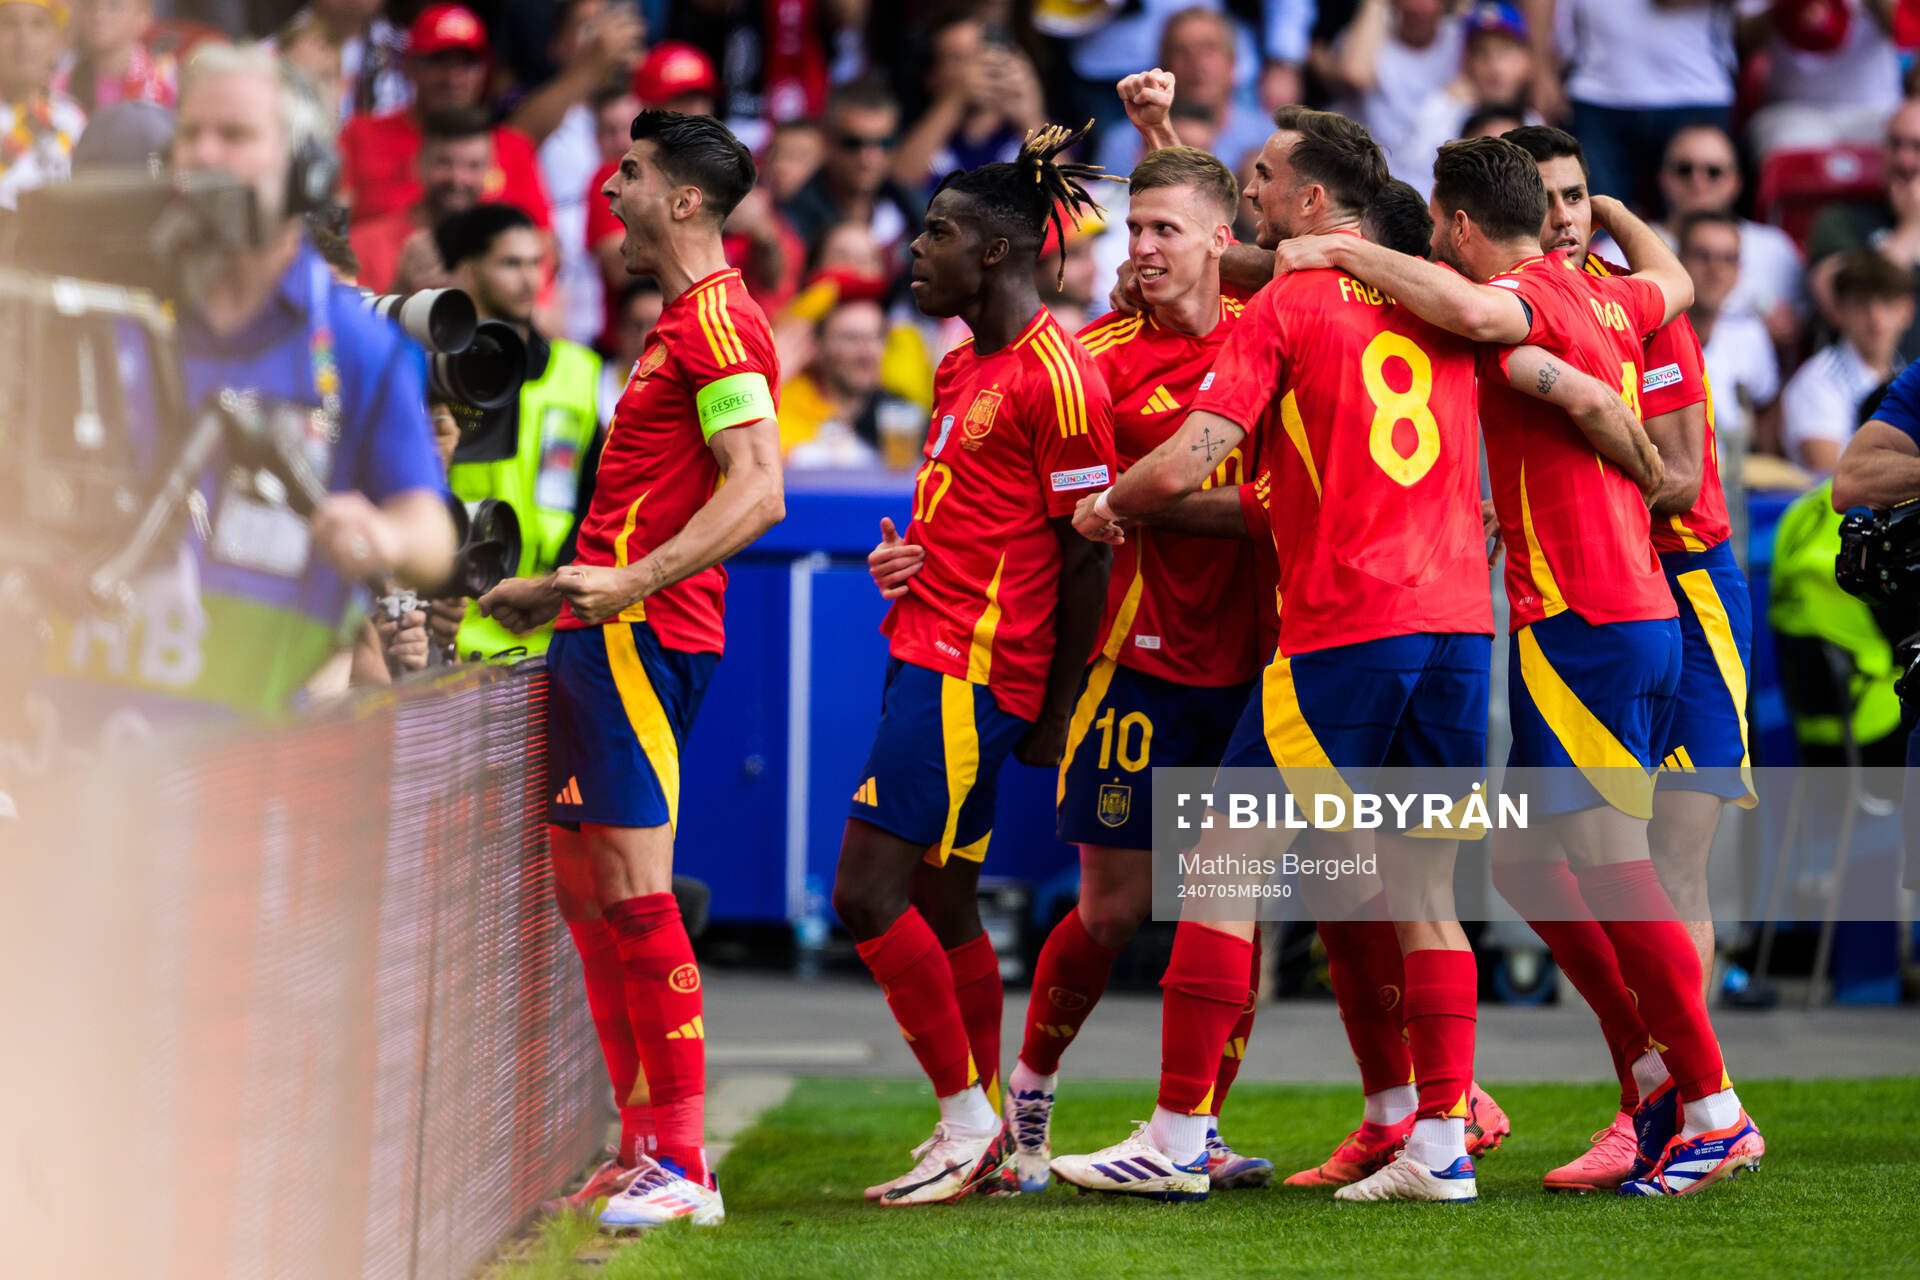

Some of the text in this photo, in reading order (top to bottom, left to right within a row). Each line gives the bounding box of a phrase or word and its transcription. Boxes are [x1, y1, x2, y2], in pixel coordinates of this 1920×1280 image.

[711, 393, 754, 415] RESPECT
[1361, 330, 1441, 487] 8
[914, 460, 952, 523] 17
[1095, 707, 1153, 772] 10
